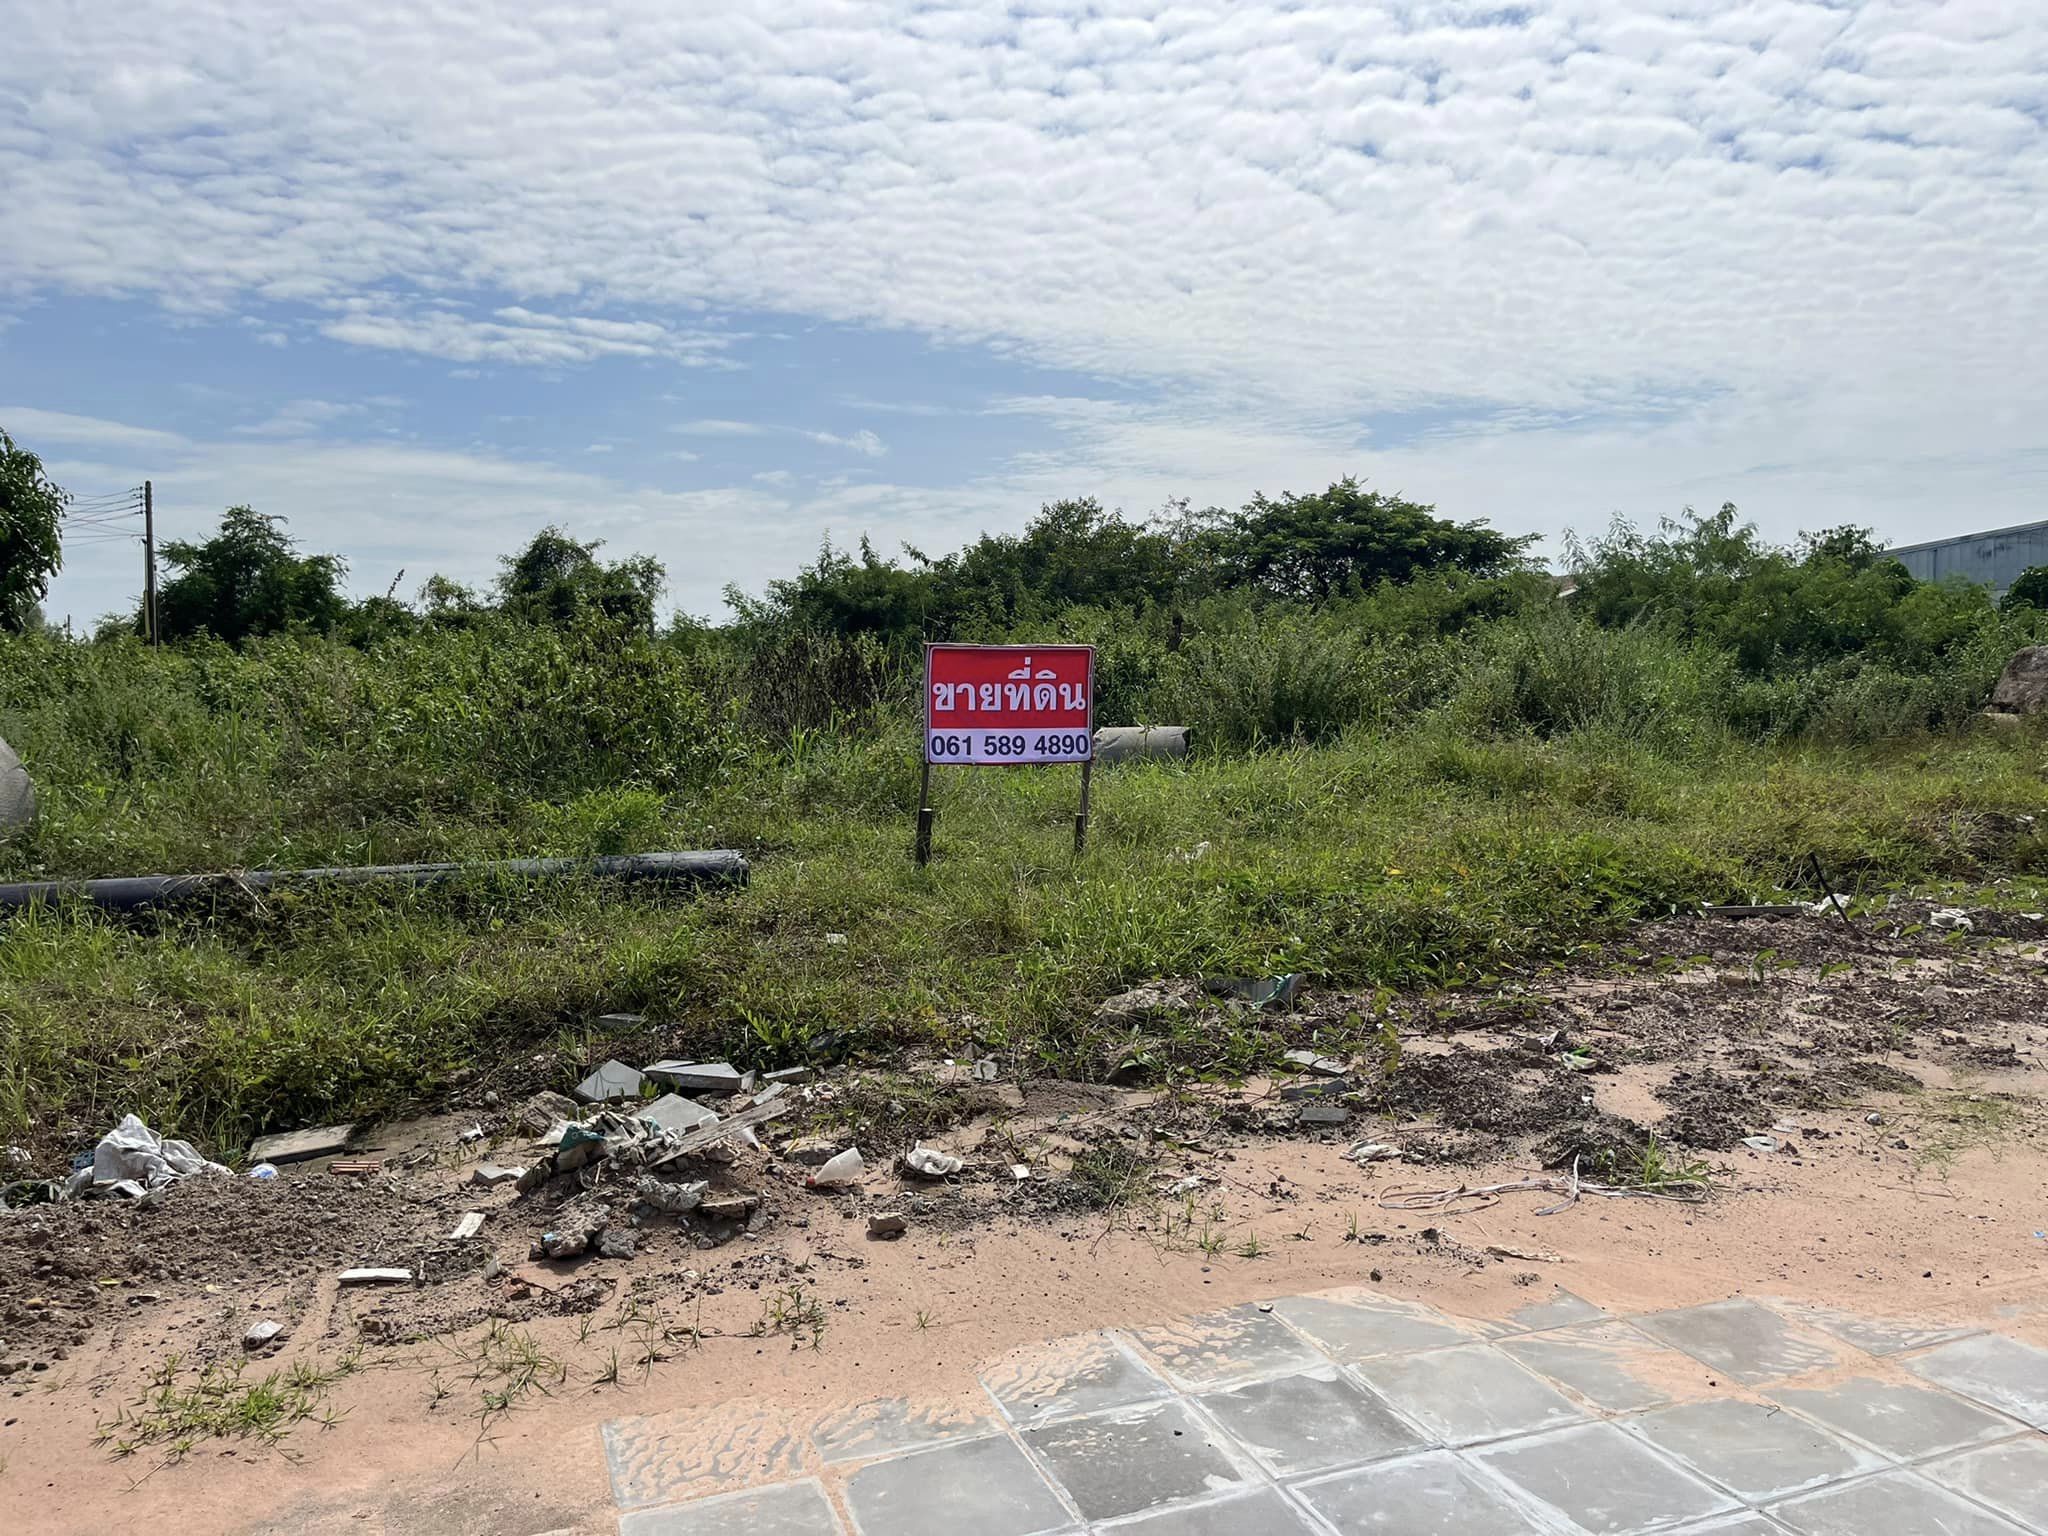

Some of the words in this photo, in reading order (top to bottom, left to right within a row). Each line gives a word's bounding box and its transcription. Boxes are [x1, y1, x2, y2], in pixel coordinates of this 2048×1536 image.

[932, 657, 1087, 711] ขายที่ดิน
[931, 736, 972, 756] 061
[983, 736, 1025, 755] 589
[1033, 734, 1089, 755] 4890
